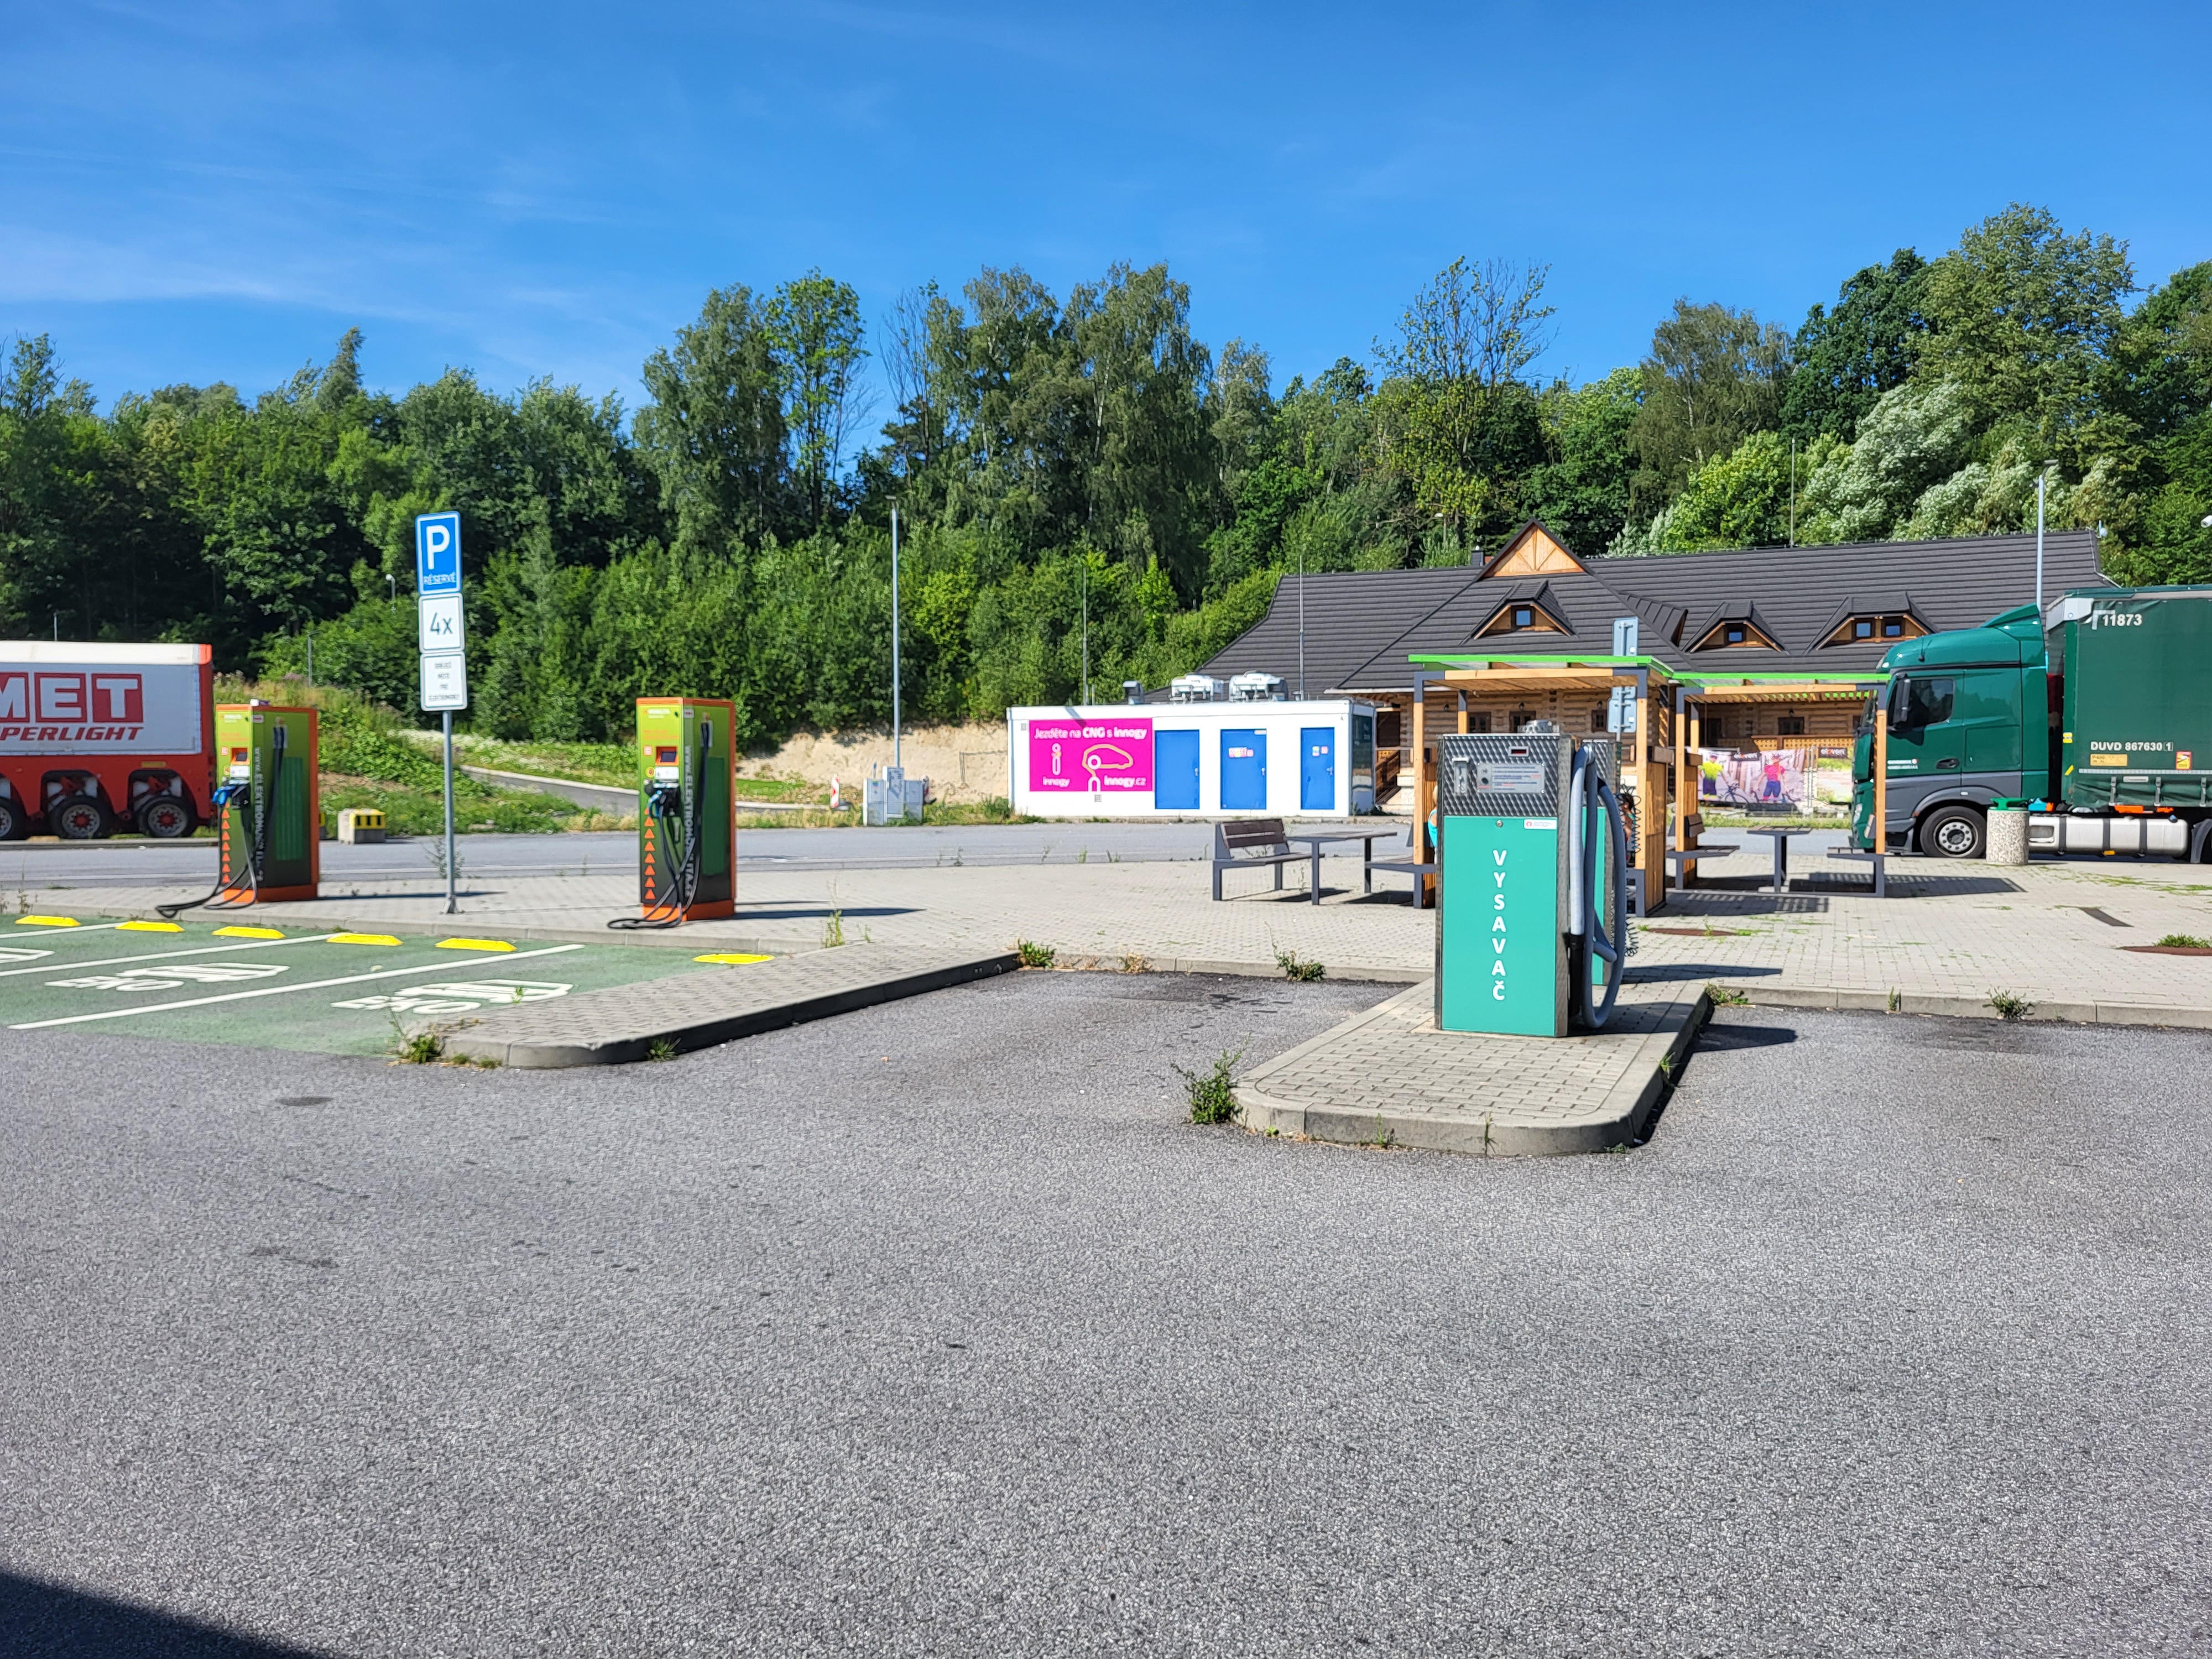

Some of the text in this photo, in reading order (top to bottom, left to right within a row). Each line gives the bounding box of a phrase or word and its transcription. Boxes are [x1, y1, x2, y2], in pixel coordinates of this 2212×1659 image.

[426, 525, 450, 570] P
[430, 612, 453, 635] 4x
[2103, 614, 2142, 626] 11873
[0, 727, 144, 741] PERLIGHT
[1070, 729, 1082, 738] na
[1083, 727, 1105, 738] CNG
[1107, 729, 1113, 738] s
[1114, 727, 1147, 740] innogy
[2090, 742, 2122, 751] DUVD
[2125, 742, 2163, 751] 867630
[1042, 776, 1071, 787] innogy
[1491, 849, 1507, 1001] VYSAVAČ
[44, 975, 185, 992] EKO
[330, 995, 482, 1014] EKO
